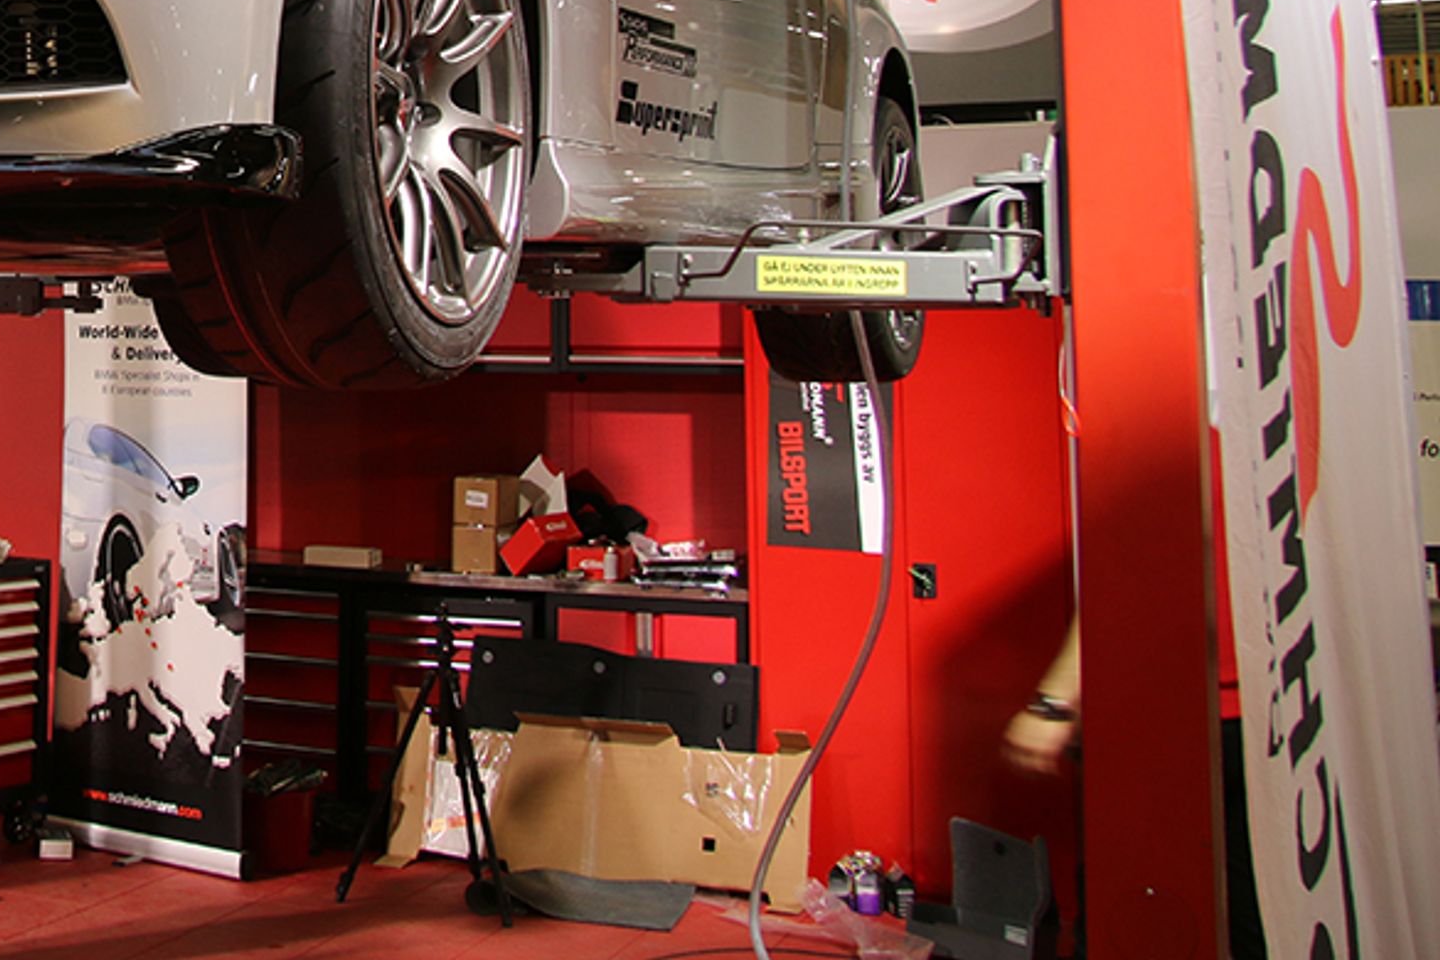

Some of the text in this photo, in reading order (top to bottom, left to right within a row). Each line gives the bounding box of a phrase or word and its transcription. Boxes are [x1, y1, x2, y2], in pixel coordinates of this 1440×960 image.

[616, 80, 718, 142] Supersprint
[78, 325, 159, 339] World-Wide
[111, 348, 121, 361] &
[778, 421, 811, 534] BILSPORT
